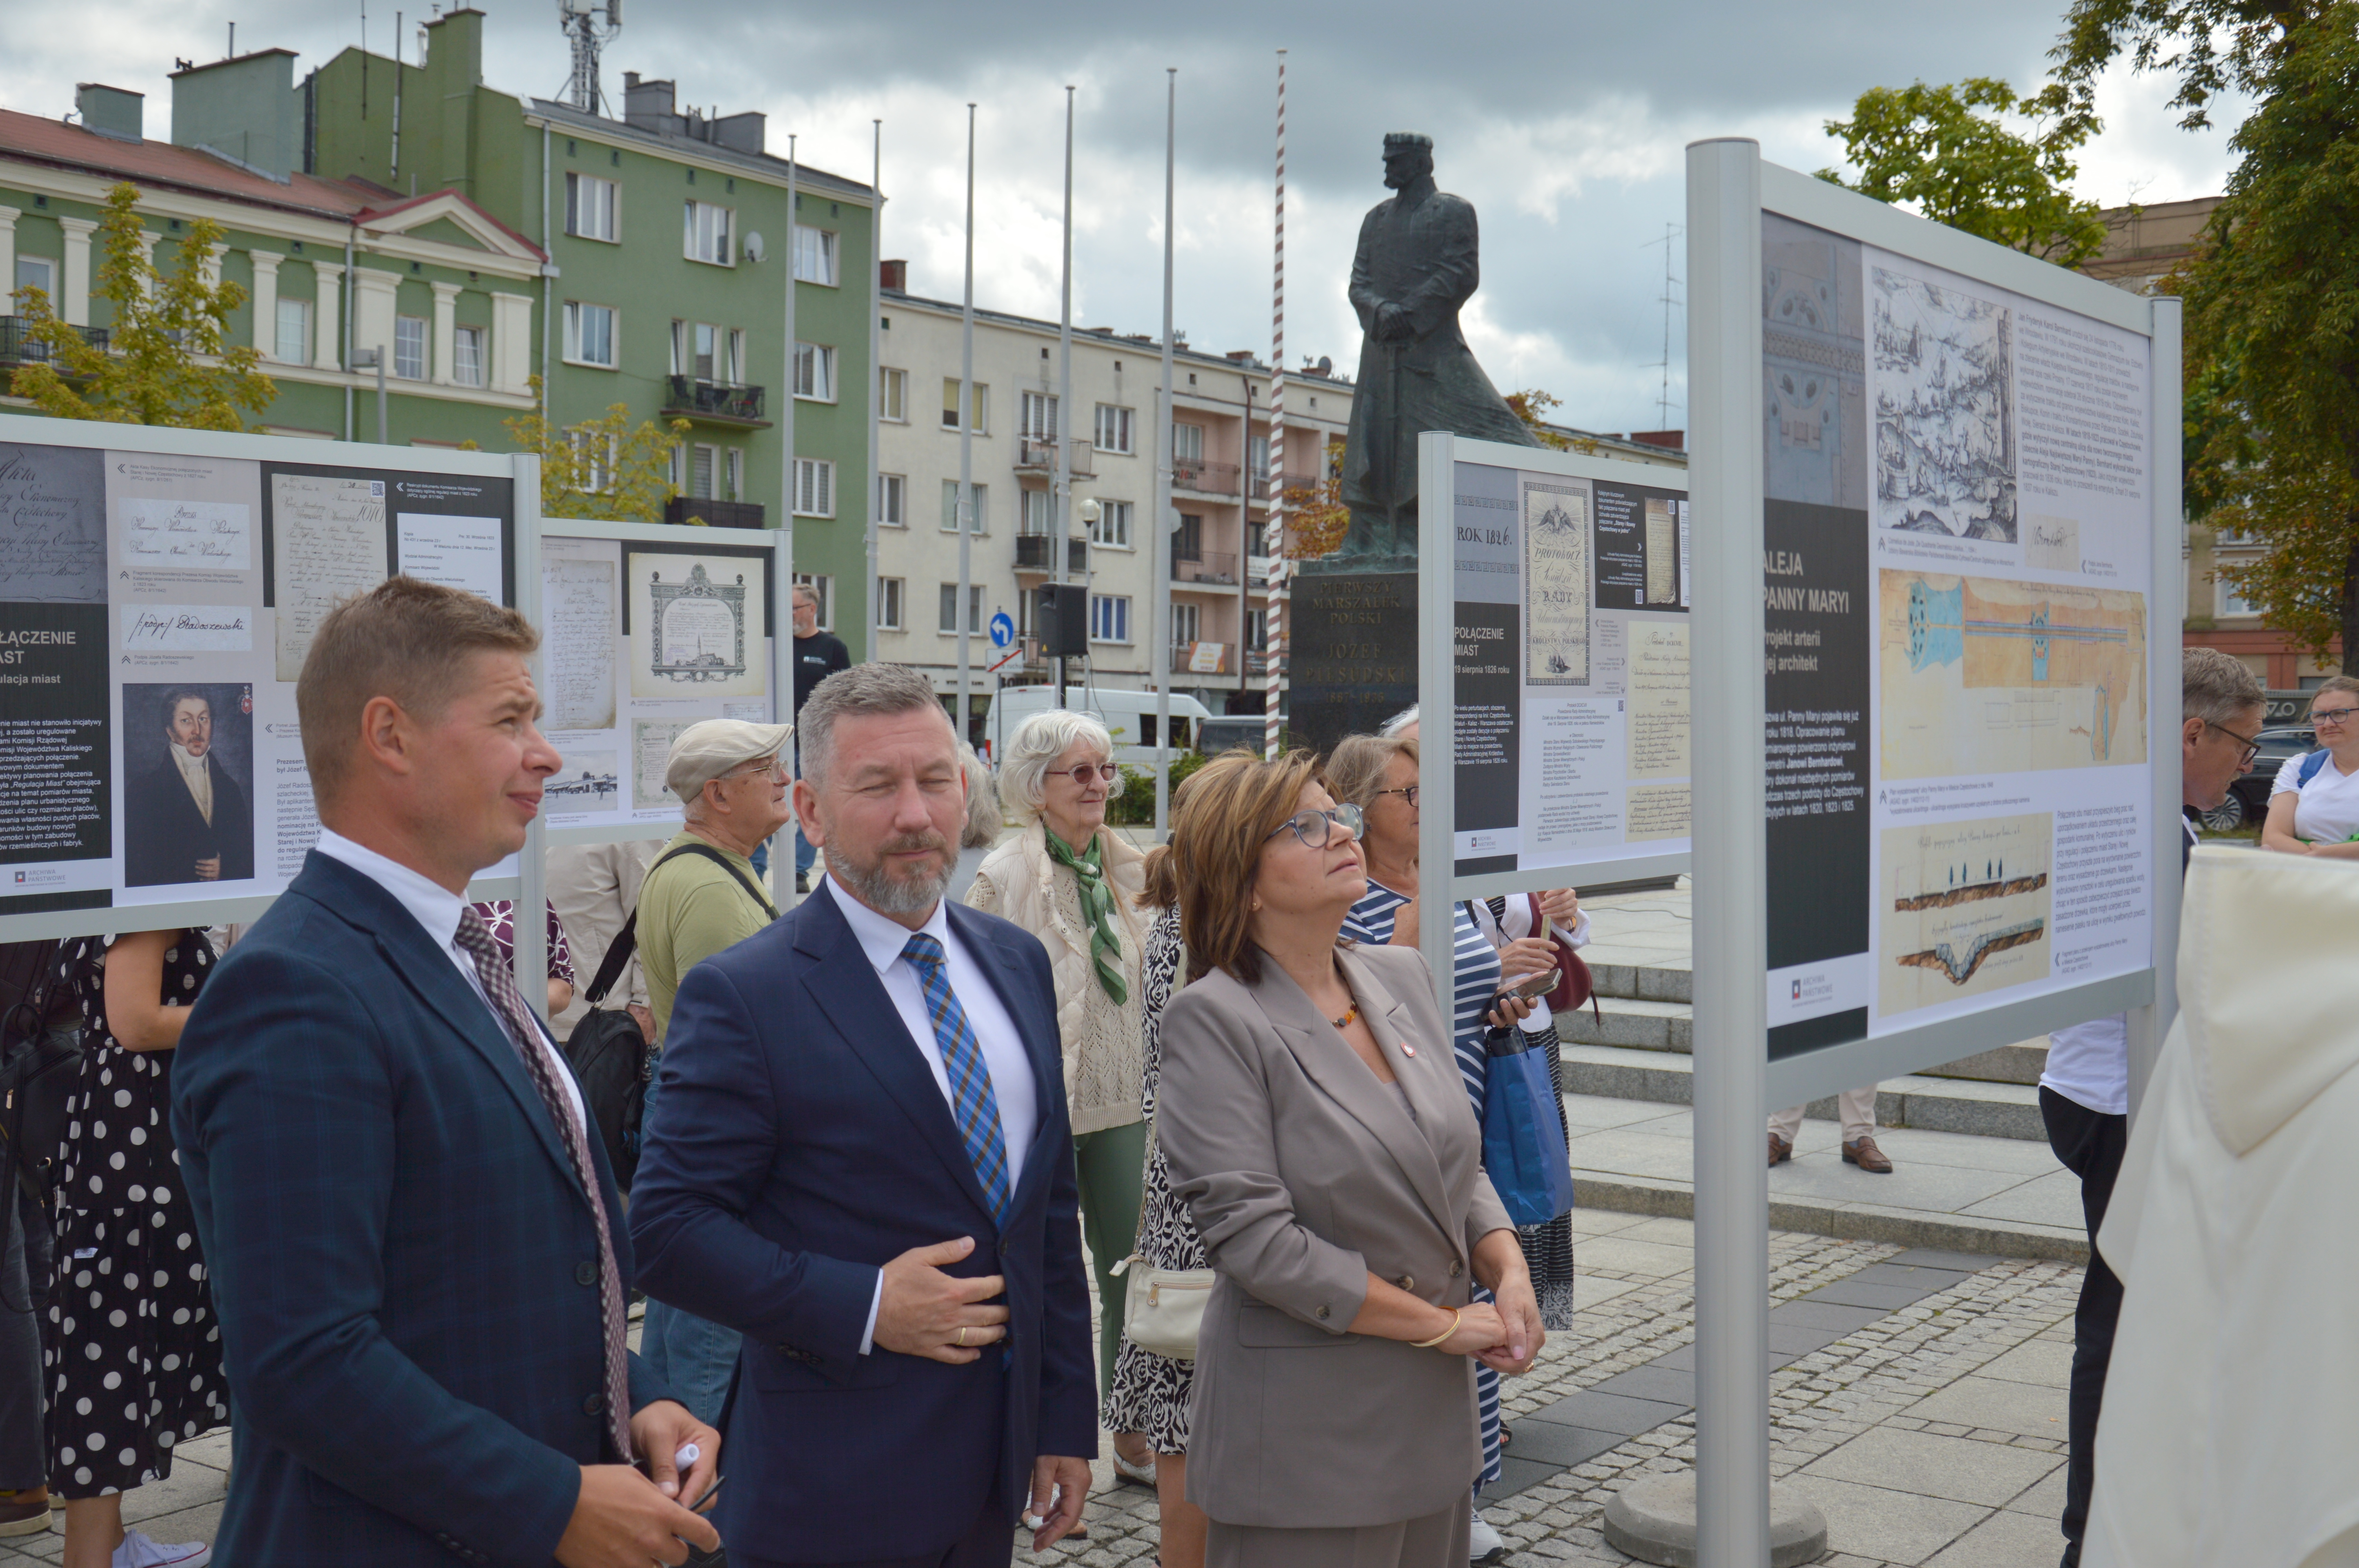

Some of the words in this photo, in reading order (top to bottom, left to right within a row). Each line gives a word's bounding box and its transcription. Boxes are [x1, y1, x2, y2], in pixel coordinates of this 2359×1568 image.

[1457, 526, 1483, 543] ROK
[1319, 582, 1393, 594] PIERWSZY
[1808, 588, 1849, 614] MARYI
[1330, 612, 1382, 624] POLSKI
[1454, 627, 1504, 642] POŁĄCZENIE
[1765, 629, 1793, 649] rojekt
[1794, 630, 1821, 647] arterii
[1454, 644, 1479, 656] MIAST
[1778, 655, 1818, 671] architekt
[1455, 664, 1461, 673] 19
[1462, 665, 1483, 675] sierpnia
[1485, 665, 1497, 673] 1826
[1498, 665, 1510, 674] roku
[31, 674, 60, 683] miast
[53, 814, 77, 822] pustych
[9, 841, 58, 849] rzemieślniczych
